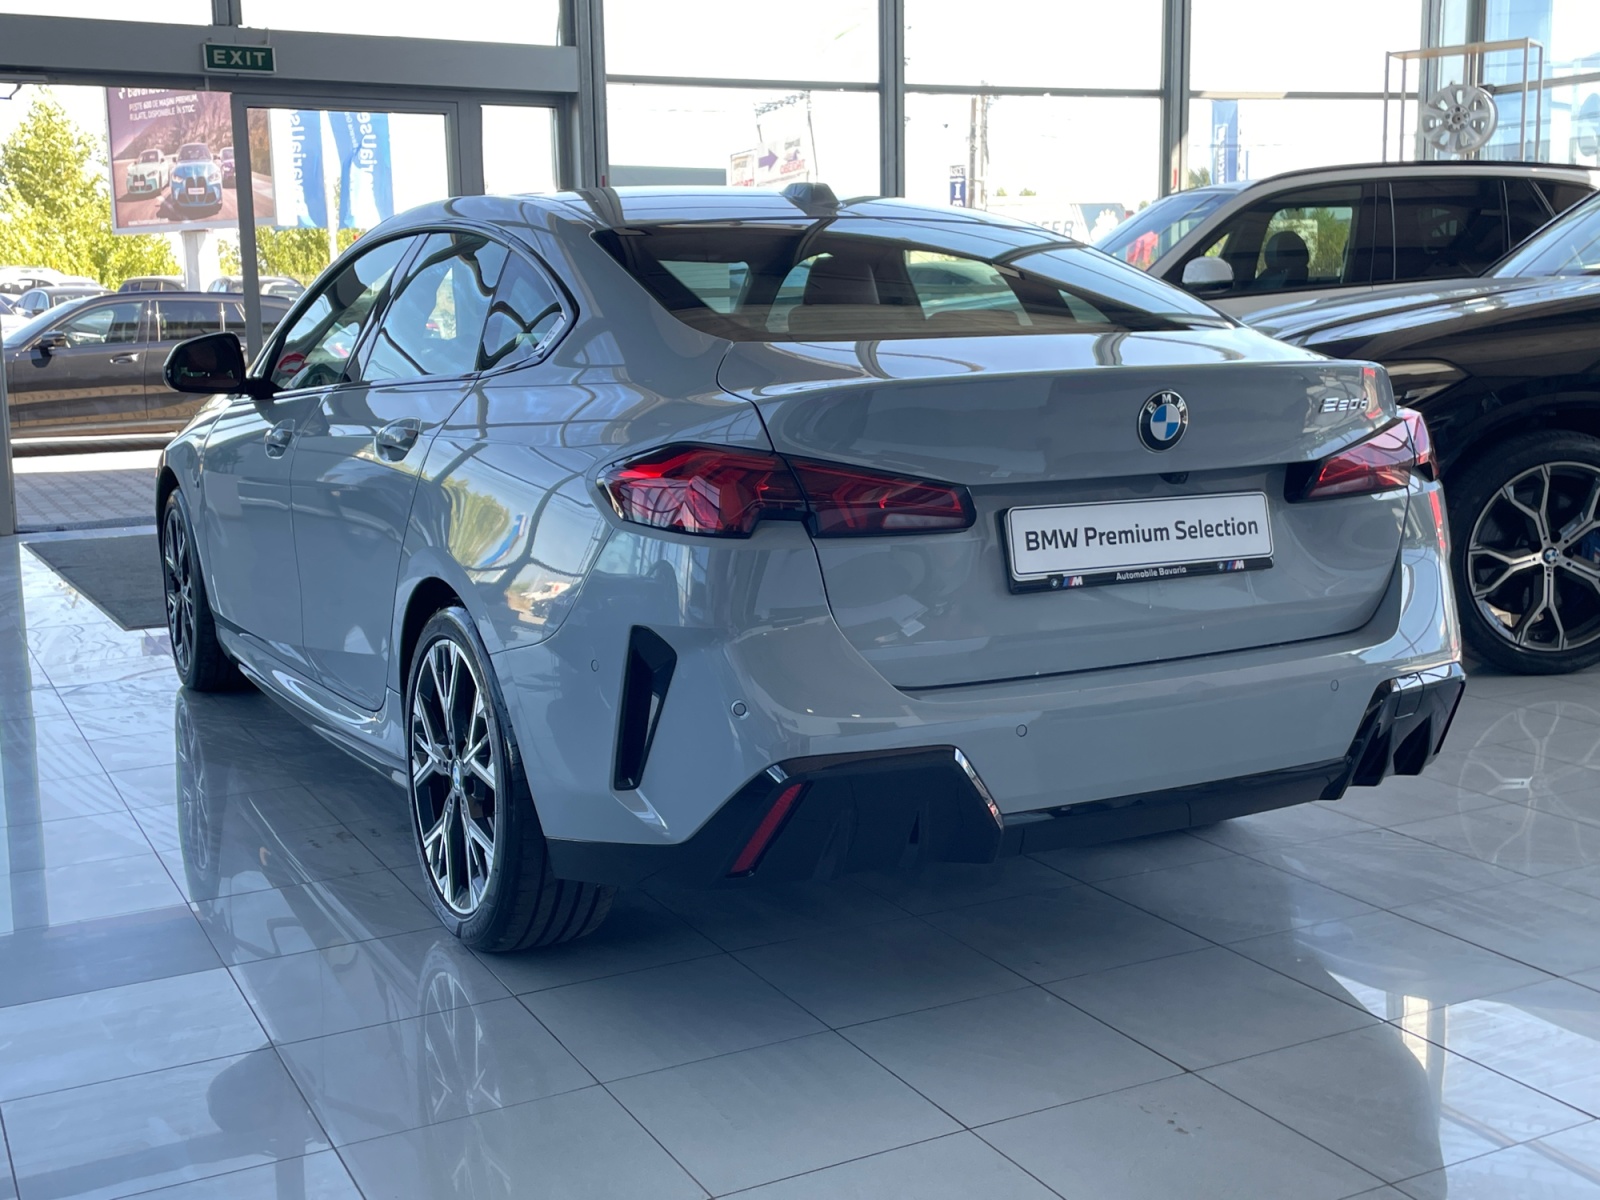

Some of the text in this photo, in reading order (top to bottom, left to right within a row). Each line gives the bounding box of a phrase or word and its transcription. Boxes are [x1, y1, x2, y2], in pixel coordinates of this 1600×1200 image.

[213, 49, 266, 67] EXIT
[1146, 393, 1187, 414] BMW
[1025, 517, 1259, 551] BMW Premium Selection
[1115, 568, 1158, 580] Automobile
[1158, 566, 1187, 576] Bavaria
